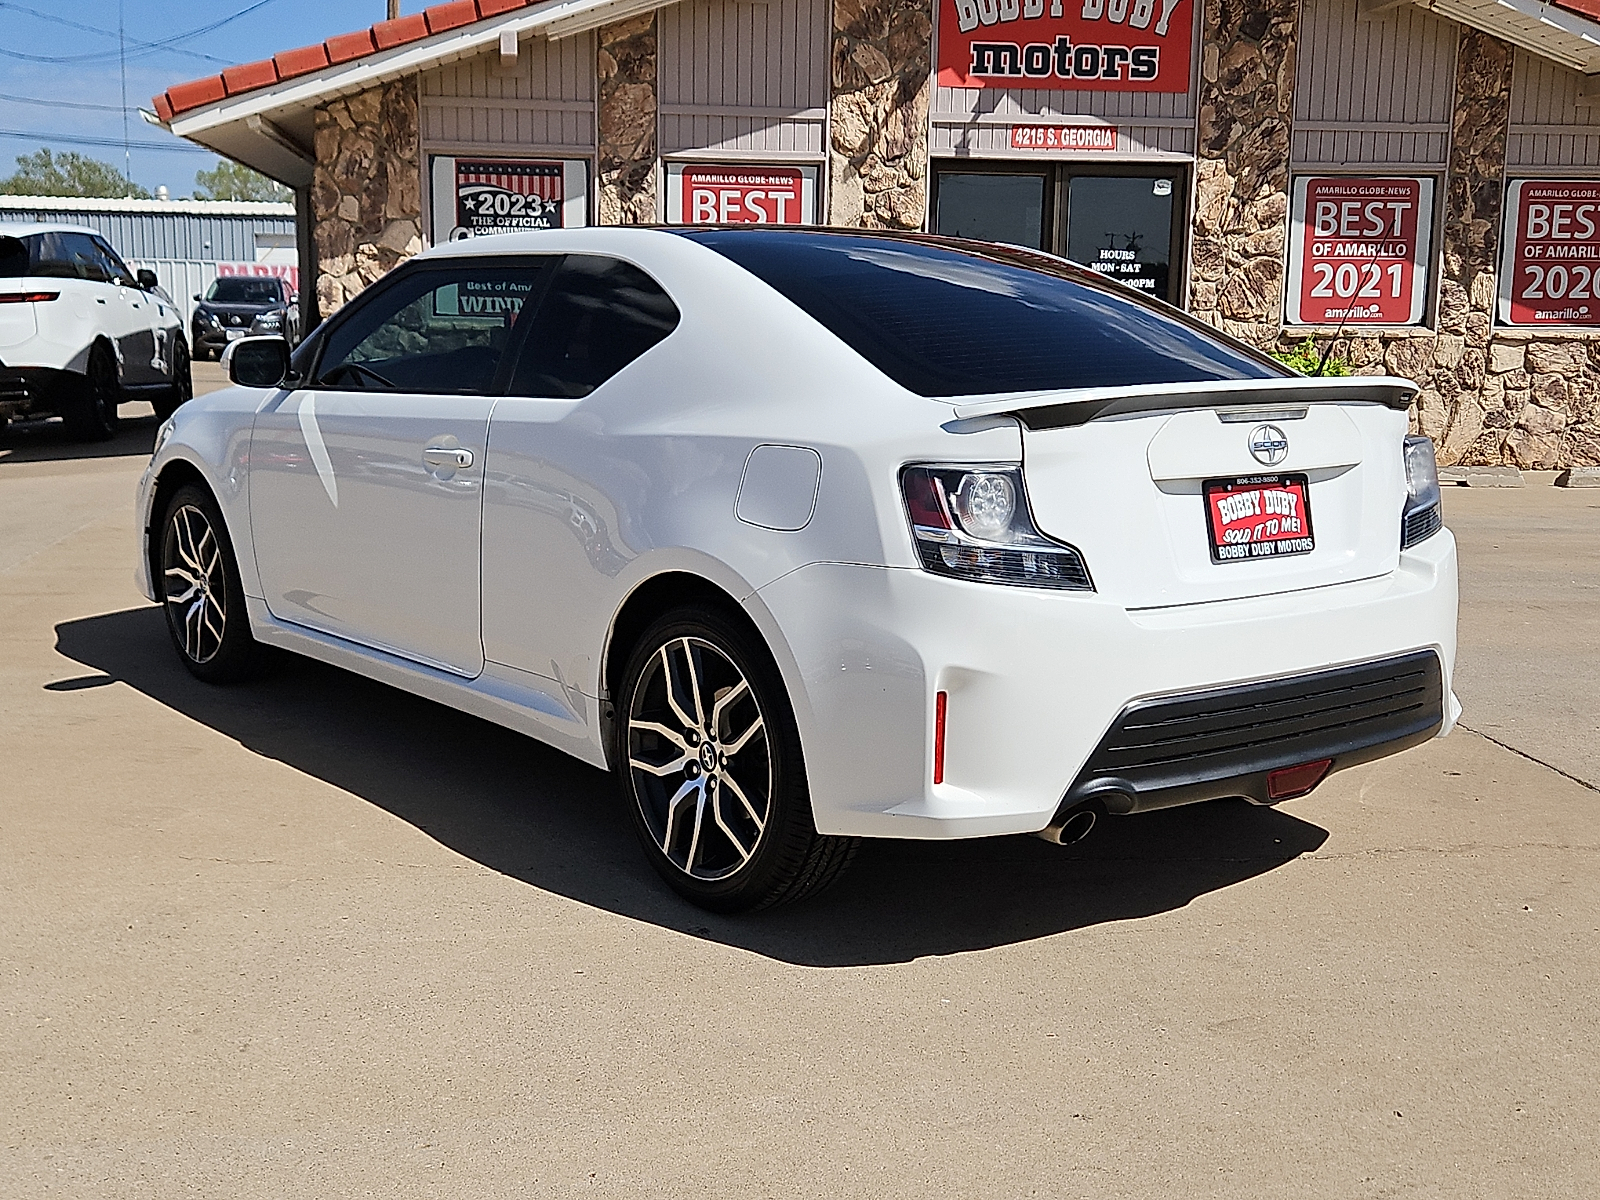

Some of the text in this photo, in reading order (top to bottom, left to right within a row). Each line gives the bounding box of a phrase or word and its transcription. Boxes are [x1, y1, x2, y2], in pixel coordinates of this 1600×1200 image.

[970, 35, 1160, 81] motors
[1015, 127, 1113, 147] 4215 S. GEORGIA
[691, 174, 794, 185] AMARILLO GLOBE-NEWS
[1315, 186, 1411, 196] AMARILLO GLOBE-NEWS
[1528, 189, 1600, 198] AMARILLO GLOBE-
[478, 193, 542, 216] 2023
[692, 189, 796, 223] BEST
[471, 216, 550, 227] THE OFFICIAL
[1314, 201, 1412, 237] BEST
[1526, 204, 1600, 239] BES
[1100, 249, 1136, 260] HOURS
[1312, 243, 1333, 256] OF
[1524, 245, 1543, 258] OF
[467, 281, 492, 291] Best
[494, 281, 508, 291] of
[1310, 262, 1403, 298] 2021
[1253, 440, 1287, 449] SCION
[1216, 490, 1298, 525] BOBBY DUBY
[1222, 516, 1301, 544] SOLD IT TO ME!
[1218, 537, 1313, 559] BOBBY DUBY MOTORS
